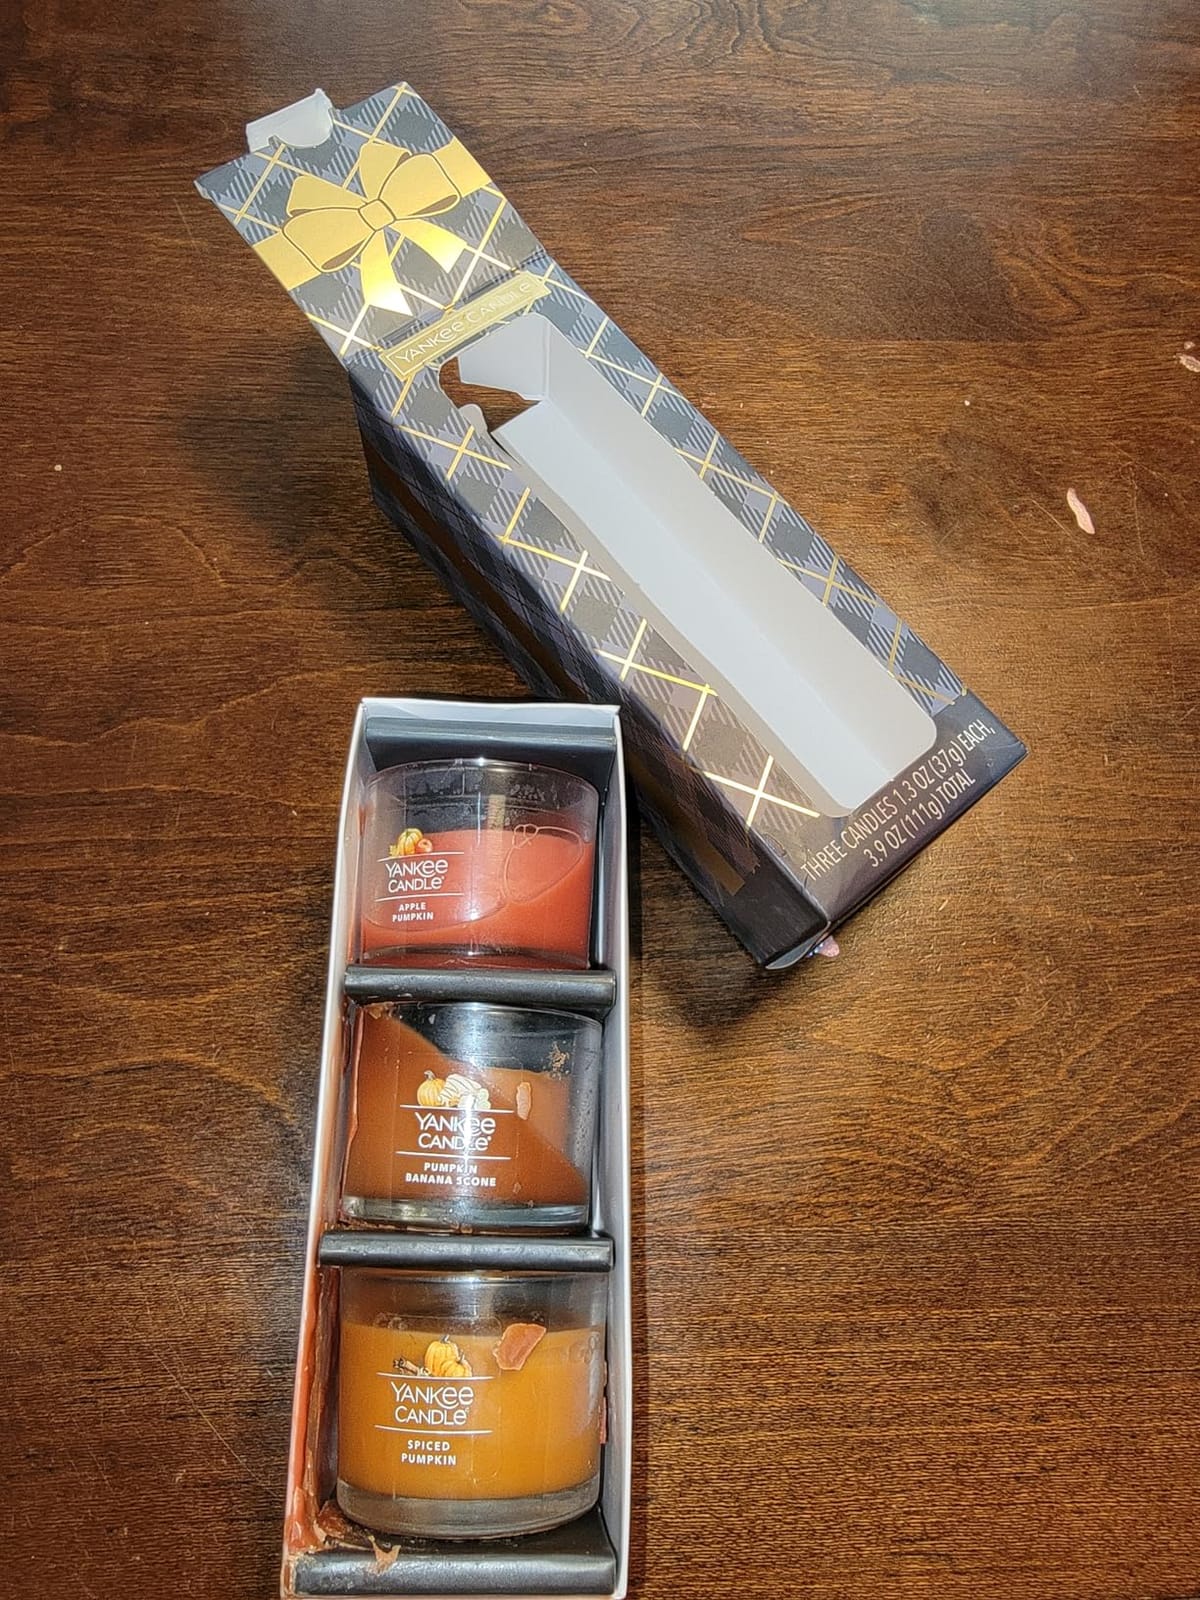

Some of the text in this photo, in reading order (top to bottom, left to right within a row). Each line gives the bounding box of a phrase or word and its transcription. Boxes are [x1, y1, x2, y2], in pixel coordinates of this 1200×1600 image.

[800, 719, 996, 881] THREE CANDLES 1.3 OZ (37g) EACH,
[864, 768, 976, 868] 3.9 OZ (111g) TOTAL
[398, 902, 427, 912] APPLE
[392, 911, 434, 923] PUMPKIN
[423, 1162, 478, 1174] PUMPKIN
[405, 1172, 497, 1187] BANANA SCONE
[407, 1439, 451, 1451] SPICED
[401, 1452, 457, 1466] PUMPKIN
